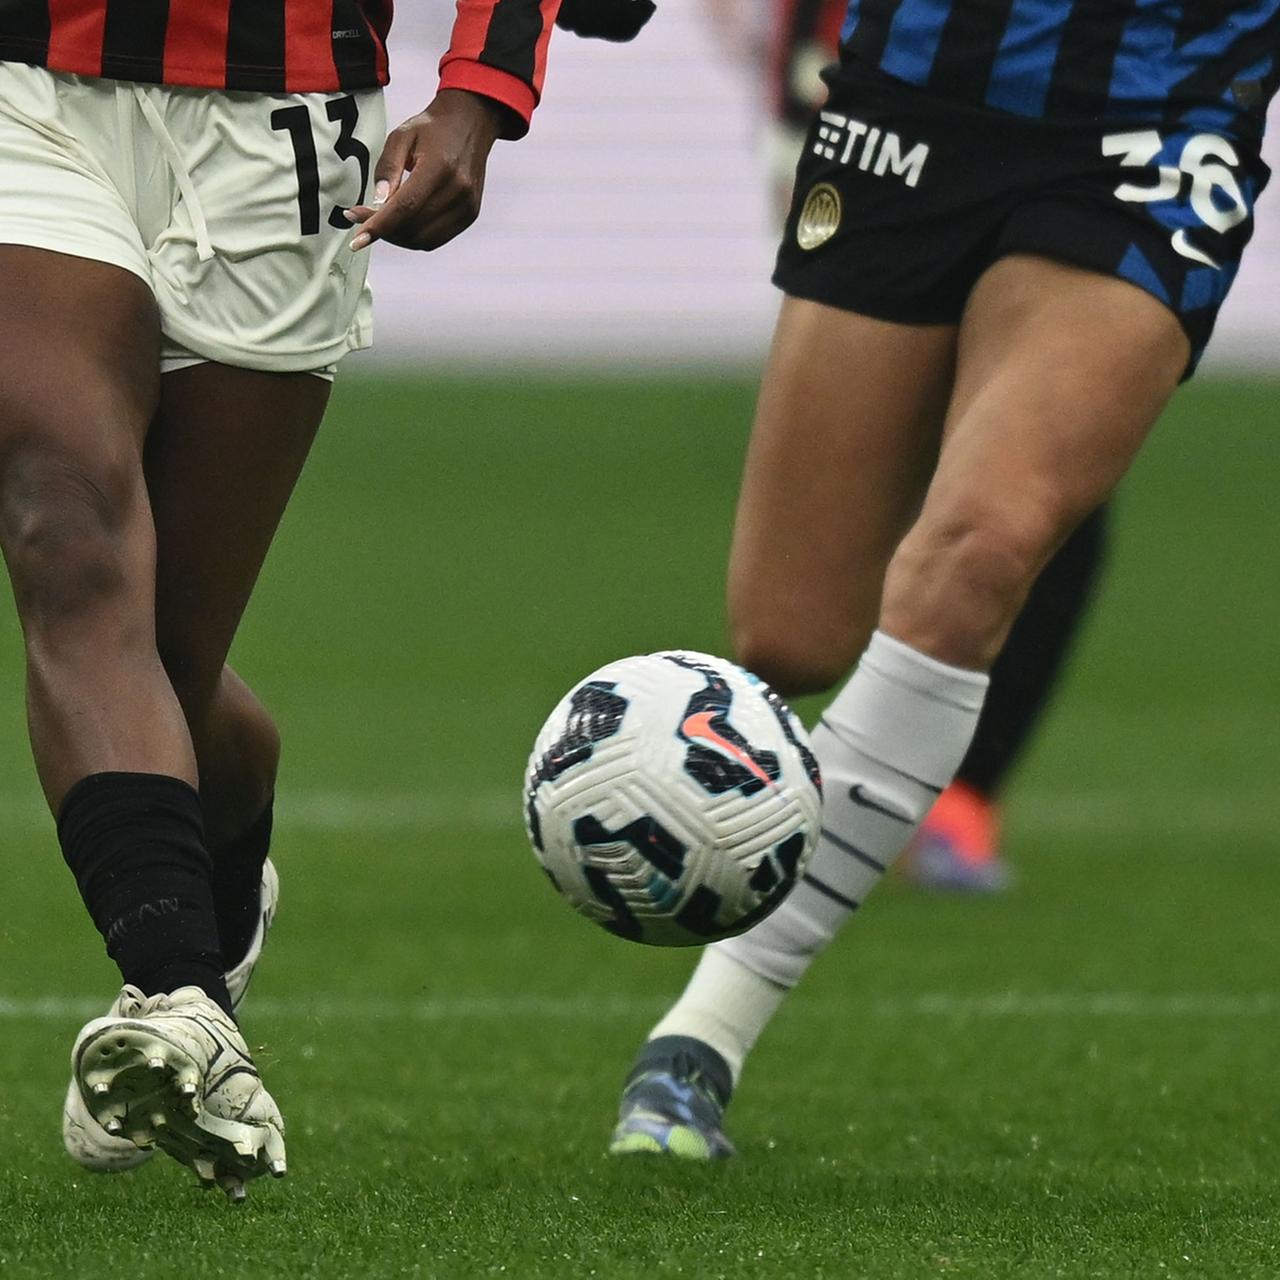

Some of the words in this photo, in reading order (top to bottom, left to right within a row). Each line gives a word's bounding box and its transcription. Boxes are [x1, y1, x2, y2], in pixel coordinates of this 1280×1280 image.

[332, 29, 361, 39] DRYCELL
[271, 95, 370, 236] 13
[839, 120, 929, 188] TIM
[1101, 129, 1249, 234] 36
